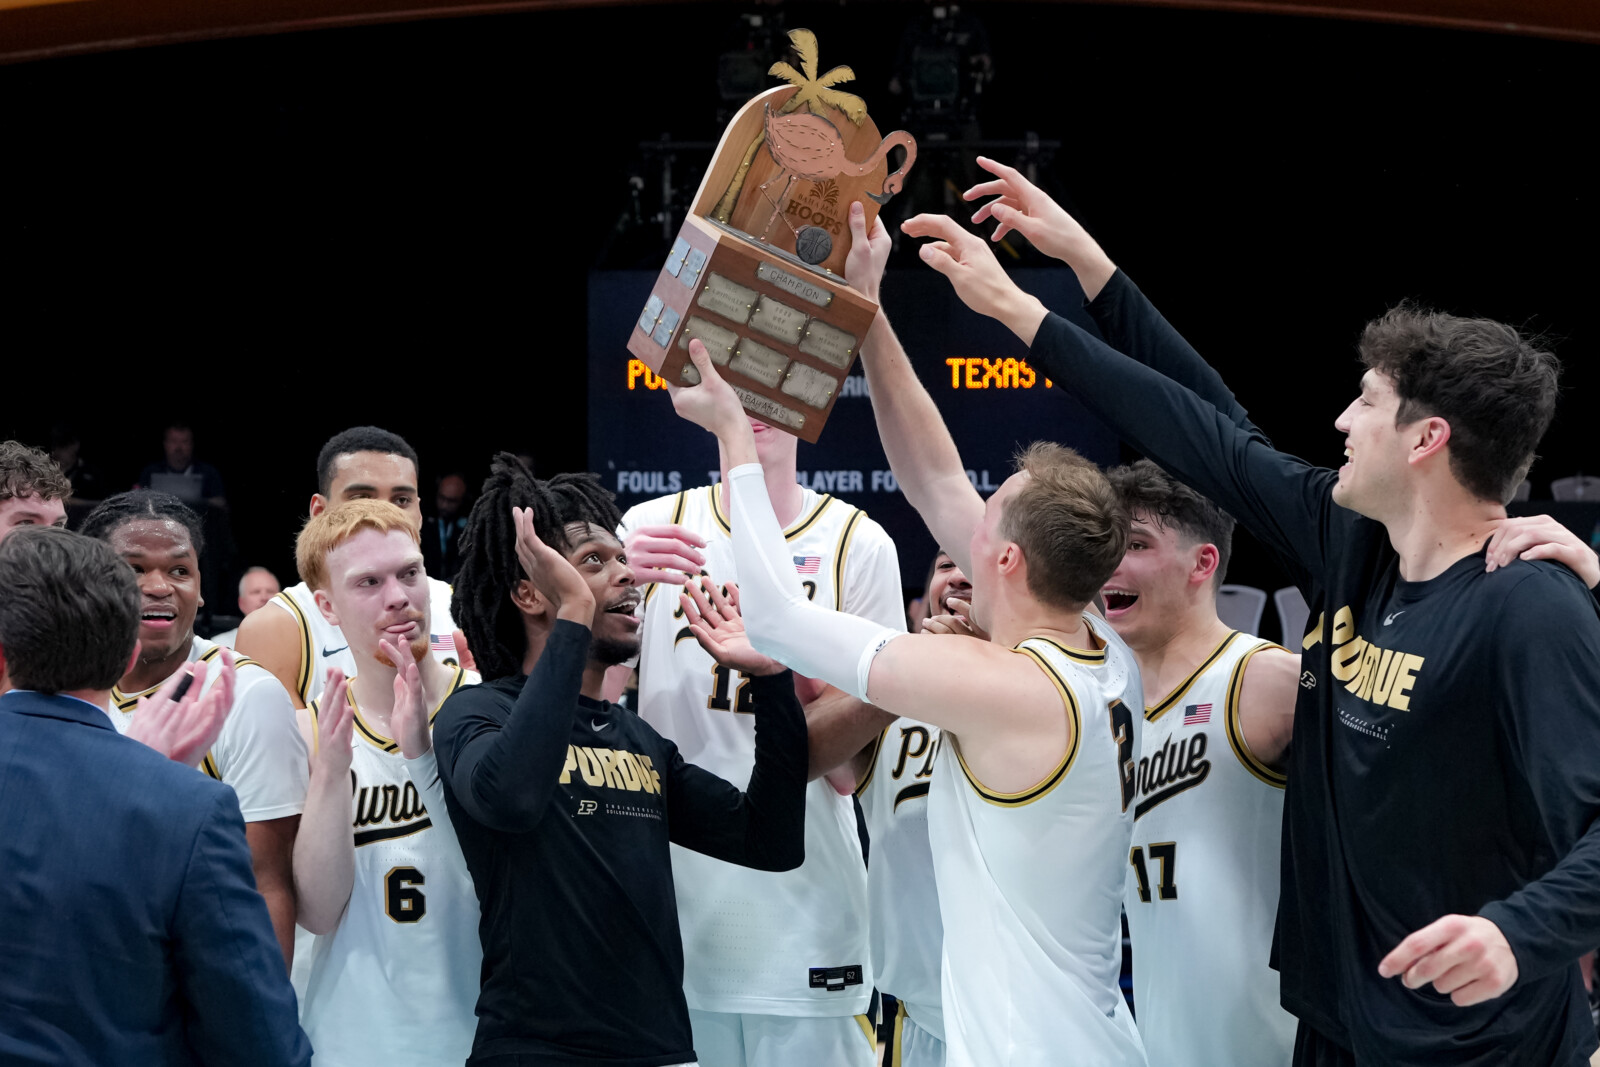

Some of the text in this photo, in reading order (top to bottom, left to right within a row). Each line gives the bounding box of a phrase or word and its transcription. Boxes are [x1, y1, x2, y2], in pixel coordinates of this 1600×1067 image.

[784, 199, 842, 236] HOOPS
[770, 270, 820, 300] CHAMPION
[946, 358, 1036, 389] TEXAS
[617, 470, 682, 493] FOULS
[872, 470, 900, 492] FO
[1108, 698, 1136, 814] 2
[1136, 732, 1212, 800] rdue
[1130, 841, 1178, 903] 17
[384, 866, 426, 923] 6
